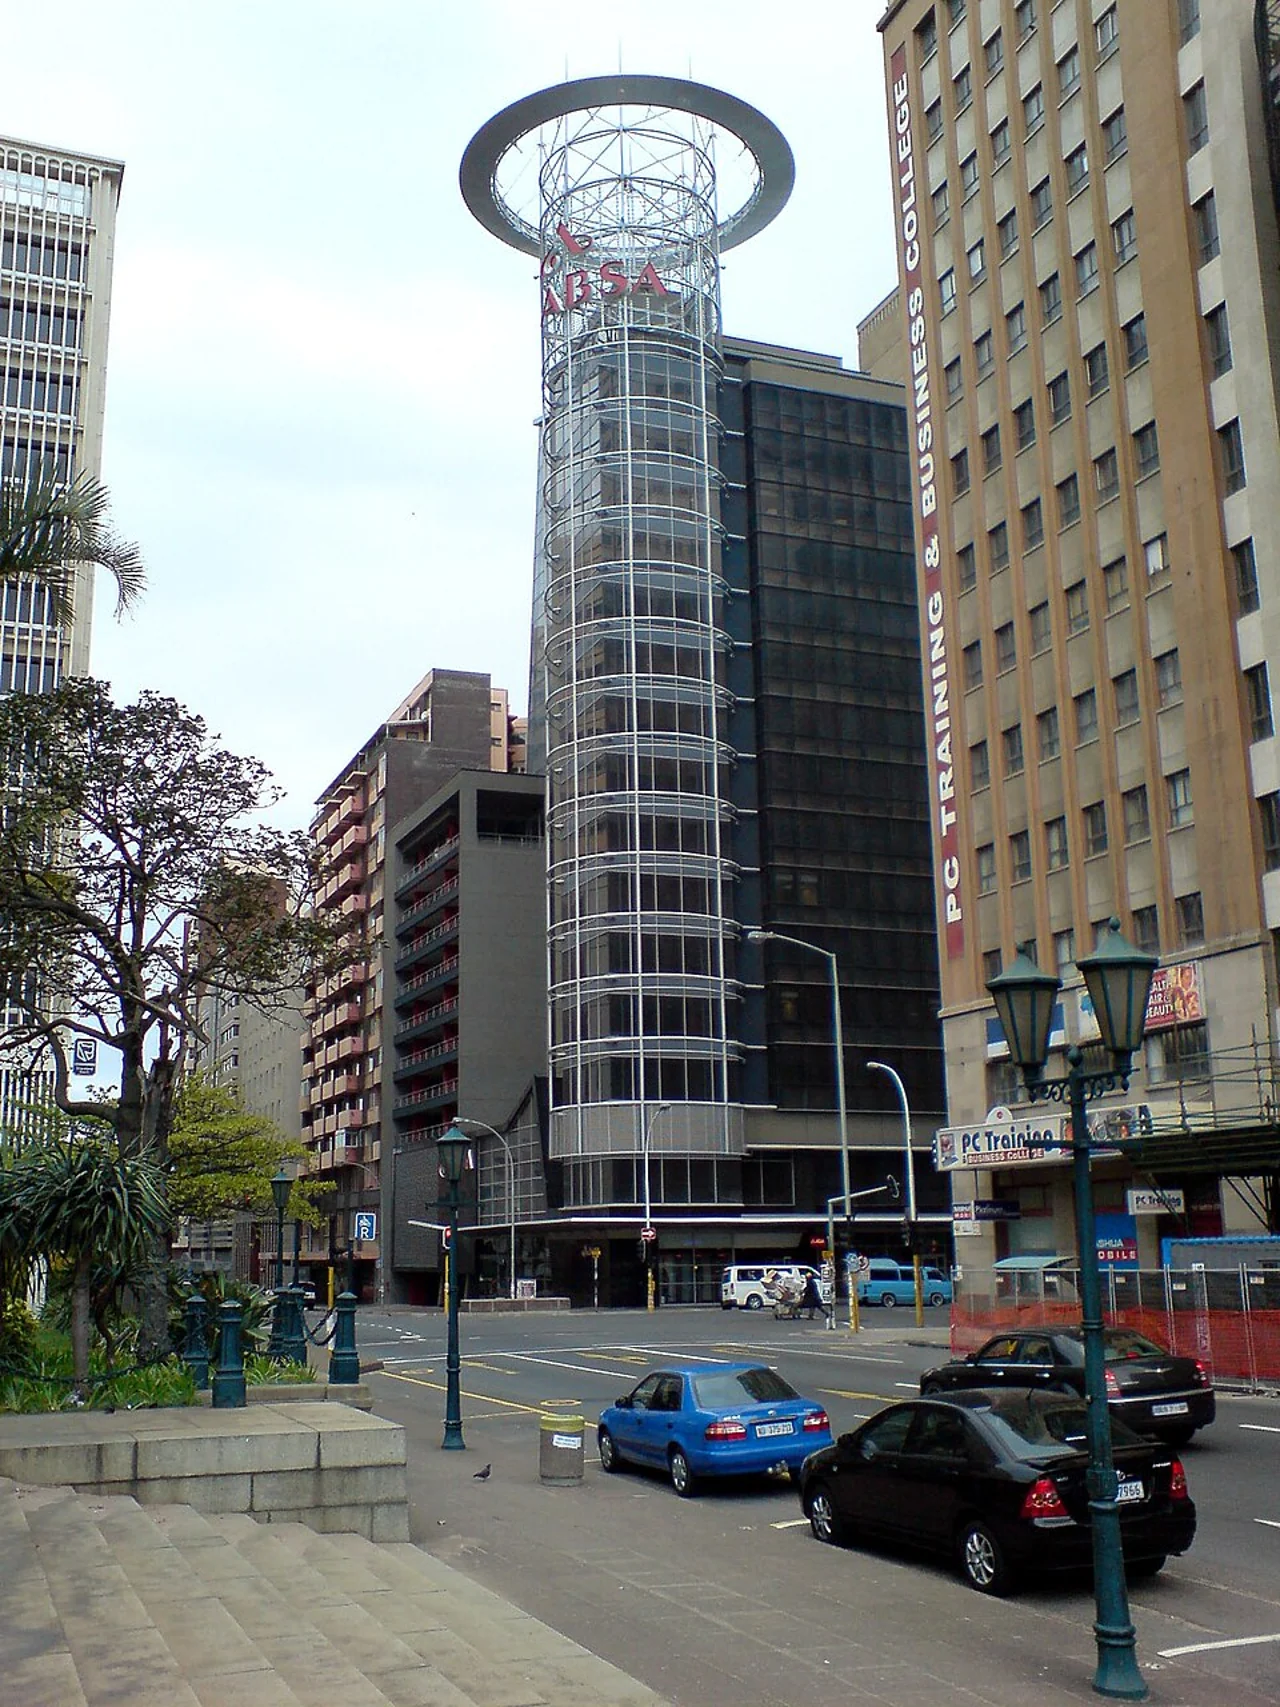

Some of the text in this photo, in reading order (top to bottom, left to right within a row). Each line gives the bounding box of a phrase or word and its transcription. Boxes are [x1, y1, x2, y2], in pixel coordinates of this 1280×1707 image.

[540, 260, 669, 314] ABSA
[893, 72, 963, 925] PC TRAINING & BUSINESS COLLEGE
[962, 1124, 1055, 1153] PC Training
[968, 1152, 1006, 1164] BUSINESS
[360, 1226, 370, 1239] R
